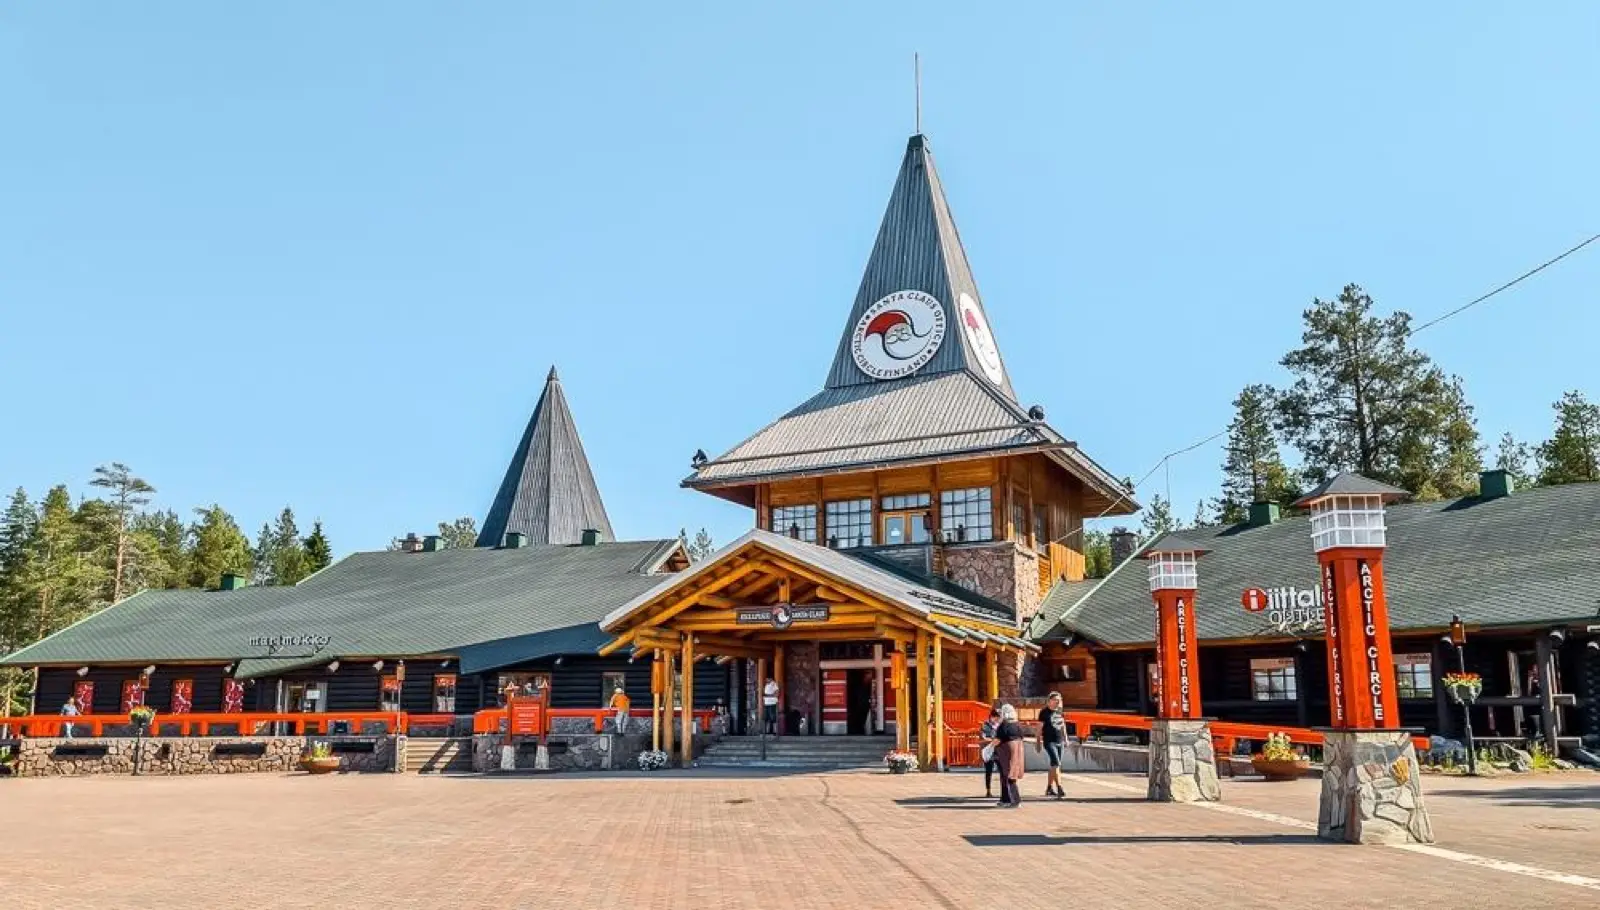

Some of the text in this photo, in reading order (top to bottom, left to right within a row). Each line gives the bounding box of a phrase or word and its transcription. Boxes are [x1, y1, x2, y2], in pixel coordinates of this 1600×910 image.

[871, 293, 904, 312] SANTA
[907, 292, 937, 309] CLAUS
[883, 354, 928, 377] FINLAND
[1267, 584, 1325, 610] iittal
[1177, 599, 1190, 713] ARCTIC CIRCLE
[1325, 565, 1343, 721] ARCTIC CIRCLE
[1361, 563, 1384, 721] ARCTIC CIRCLE
